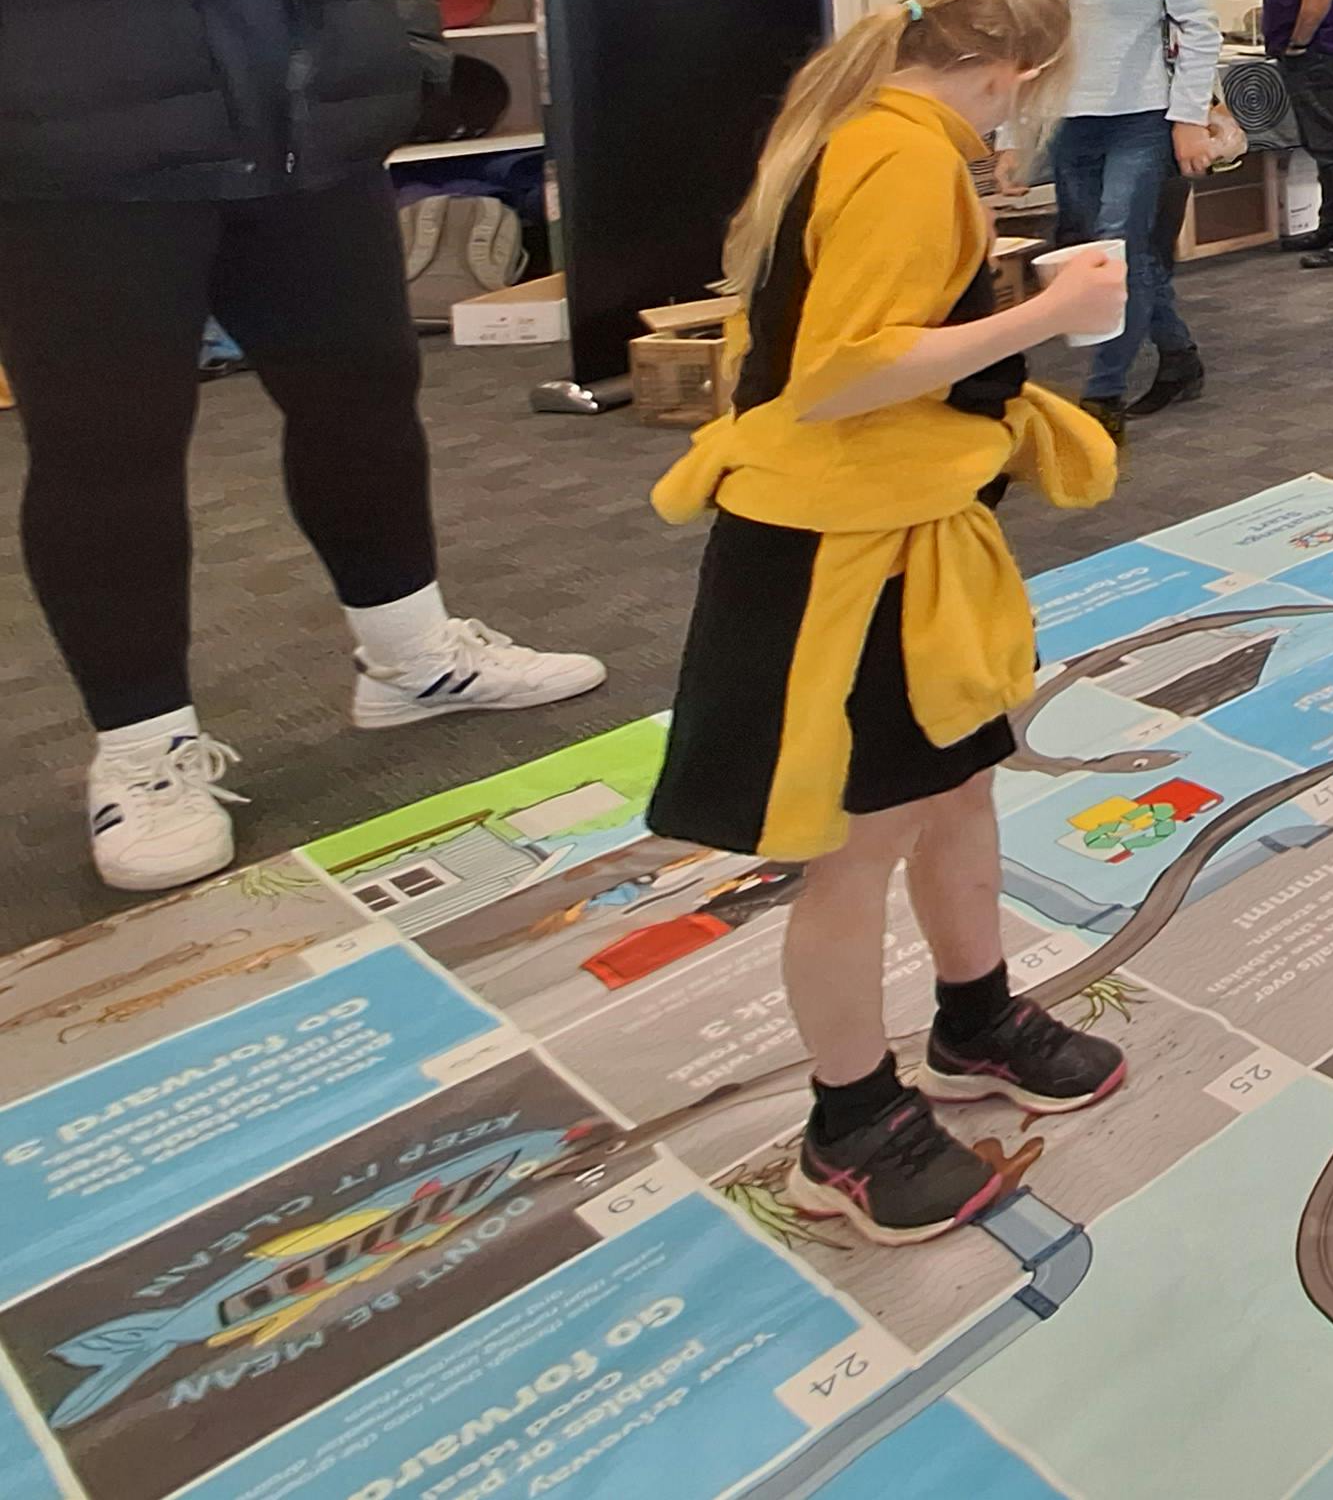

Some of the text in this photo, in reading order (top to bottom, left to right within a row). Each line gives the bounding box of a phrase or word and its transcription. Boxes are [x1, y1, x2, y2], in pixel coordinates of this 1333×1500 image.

[1247, 904, 1316, 945] stream.
[1283, 922, 1316, 942] the
[1291, 934, 1323, 953] the
[1022, 941, 1062, 969] 18
[1207, 944, 1281, 991] rubbish
[1255, 970, 1295, 1002] over
[700, 987, 785, 1038] ck 3
[667, 1018, 786, 1078] the road.
[690, 1027, 797, 1086] car with
[4, 998, 367, 1164] Go forward 3
[43, 1021, 363, 1164] of litter and leaves.
[1229, 1063, 1272, 1094] 25
[48, 1029, 376, 1181] home and kura free
[50, 1033, 392, 1197] gutters outside your
[82, 1165, 144, 1195] the
[136, 1111, 518, 1295] KEEP IT CLEAN
[606, 1177, 663, 1214] 19
[169, 1197, 541, 1407] DON'T BE MEAN
[606, 1297, 683, 1346] Go
[810, 1353, 868, 1397] 24
[518, 1340, 703, 1470] pebbles or
[525, 1372, 621, 1436] Good
[529, 1333, 774, 1496] Your driveway
